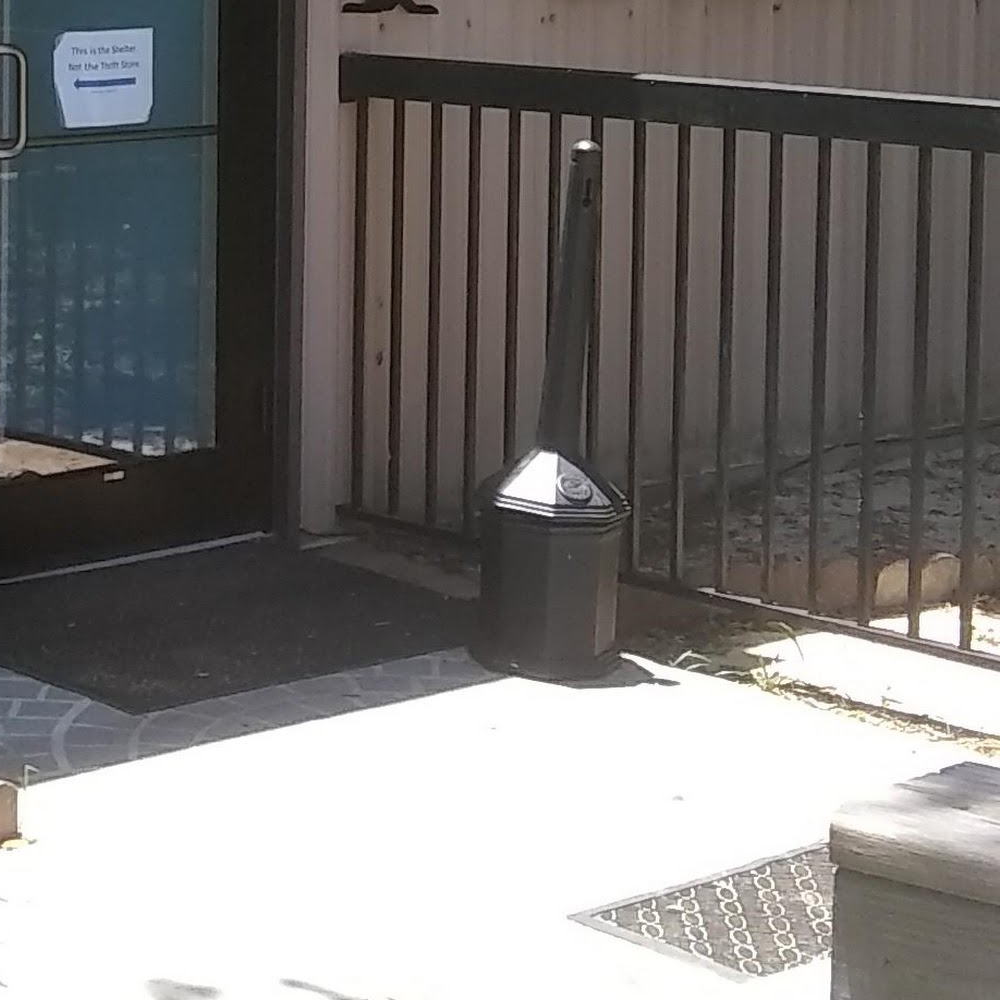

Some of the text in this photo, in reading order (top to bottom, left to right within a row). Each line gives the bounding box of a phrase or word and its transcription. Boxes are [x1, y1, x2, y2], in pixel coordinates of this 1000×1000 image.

[71, 46, 88, 56] This
[98, 46, 110, 54] the
[112, 45, 136, 54] Shelter
[84, 62, 99, 71] the
